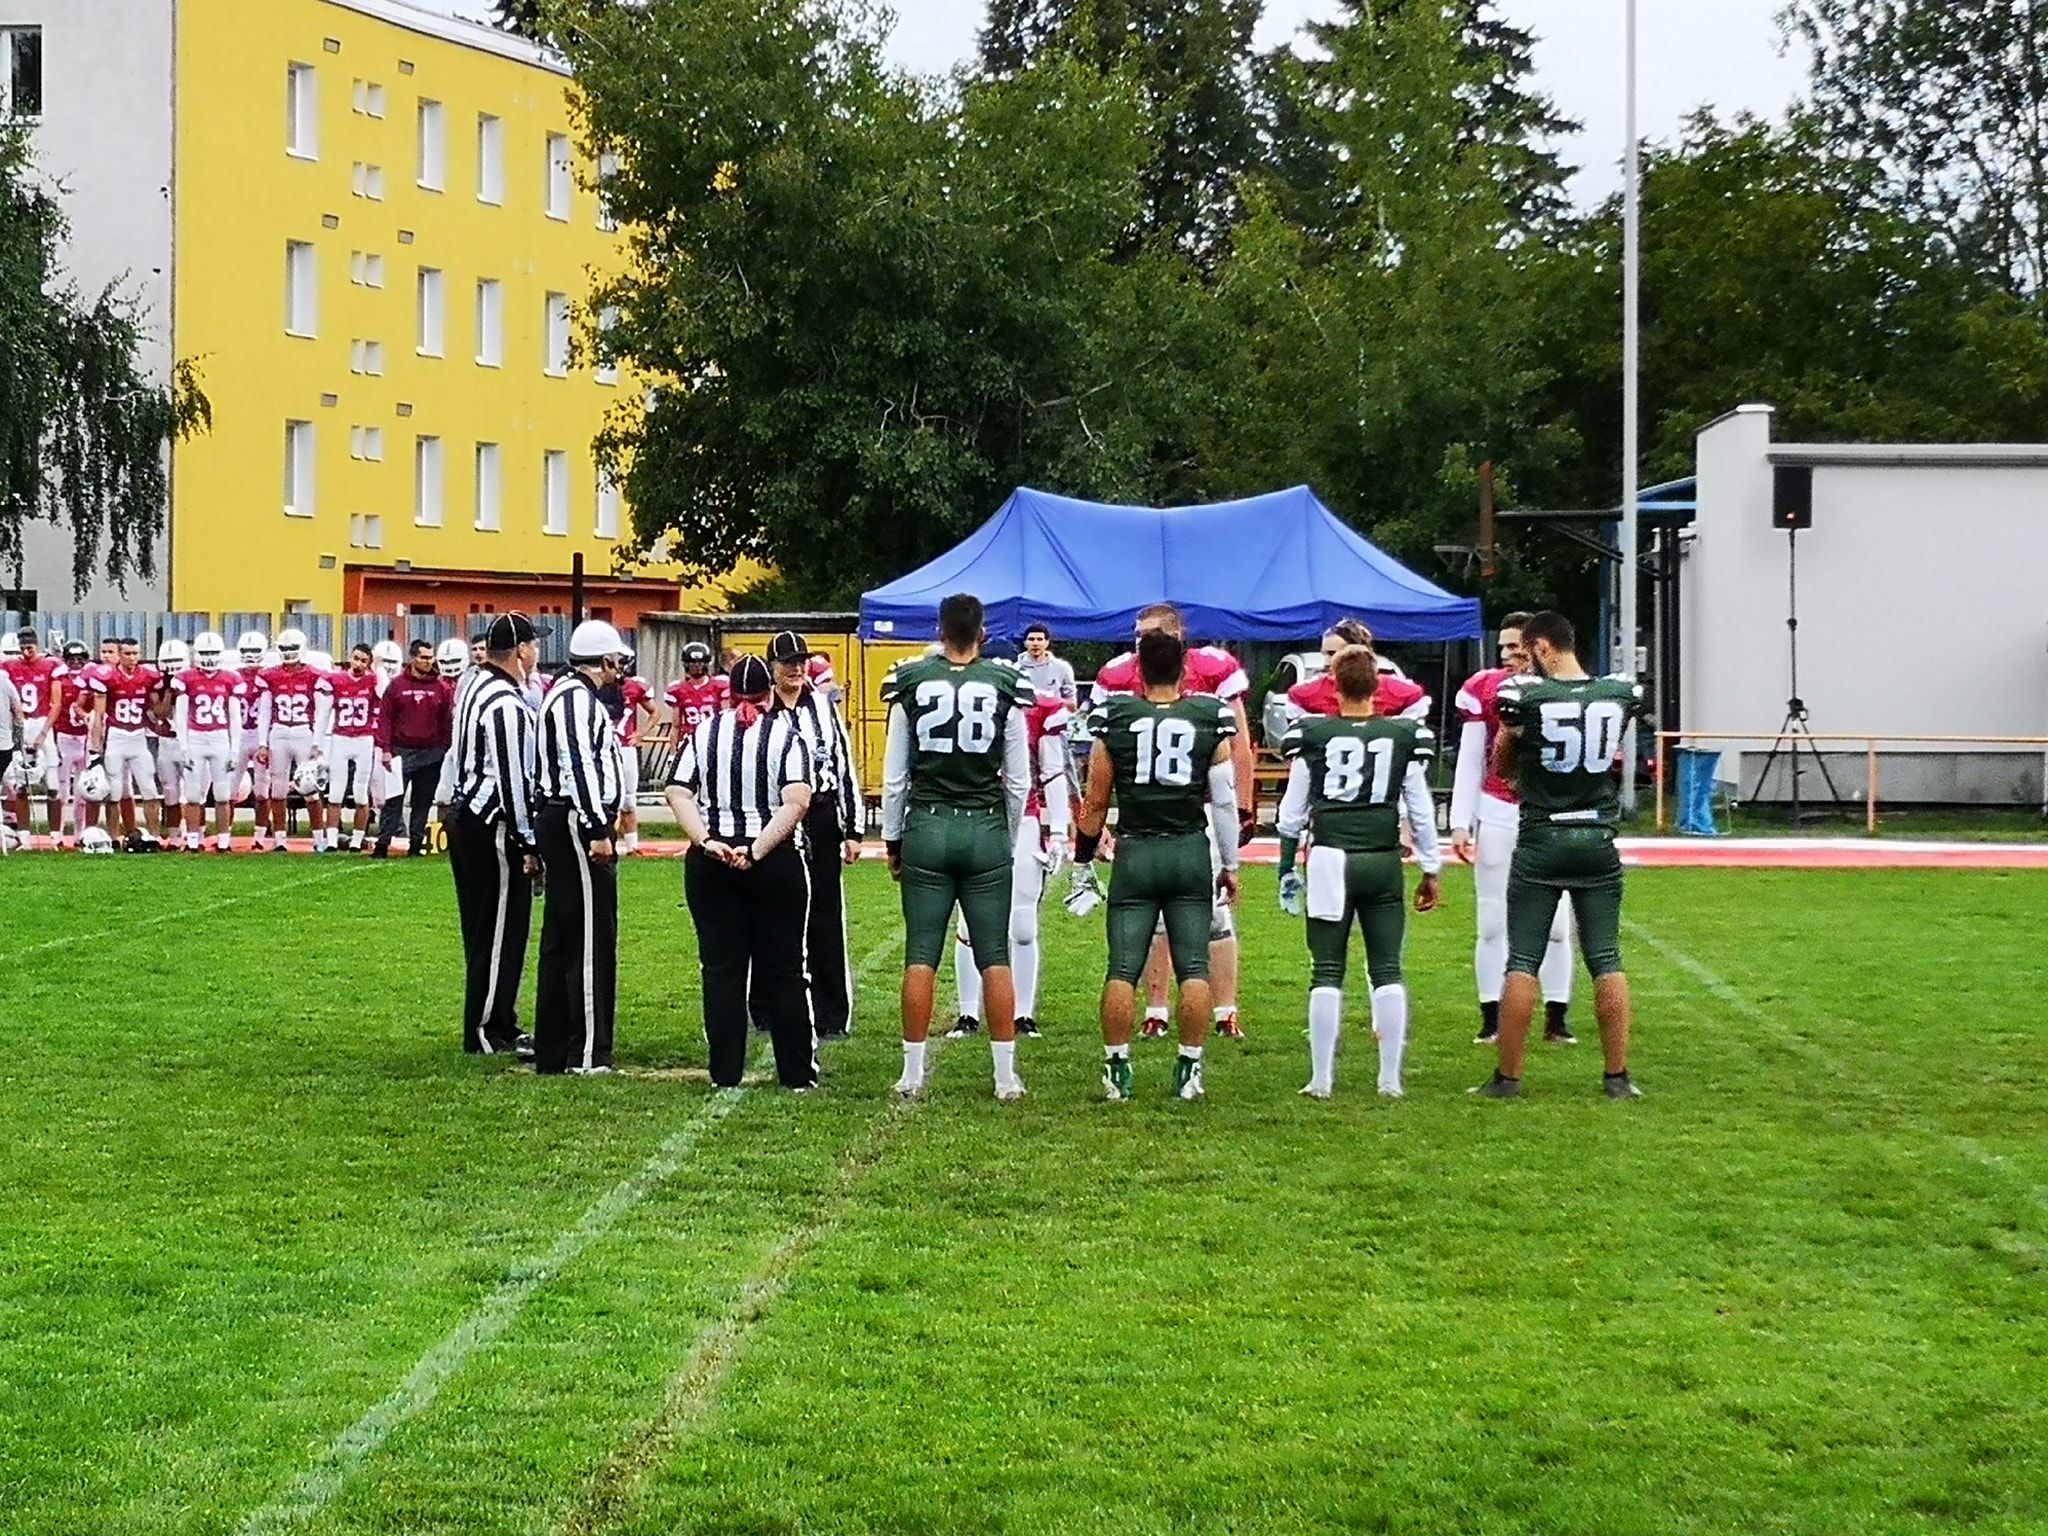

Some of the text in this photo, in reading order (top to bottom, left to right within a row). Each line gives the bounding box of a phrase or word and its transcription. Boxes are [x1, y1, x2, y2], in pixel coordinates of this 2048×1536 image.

[21, 683, 38, 713] 9
[195, 694, 227, 724] 24
[338, 697, 369, 726] 23
[916, 681, 997, 754] 28
[1129, 717, 1196, 786] 18
[1323, 736, 1394, 804] 81
[1540, 702, 1623, 773] 50
